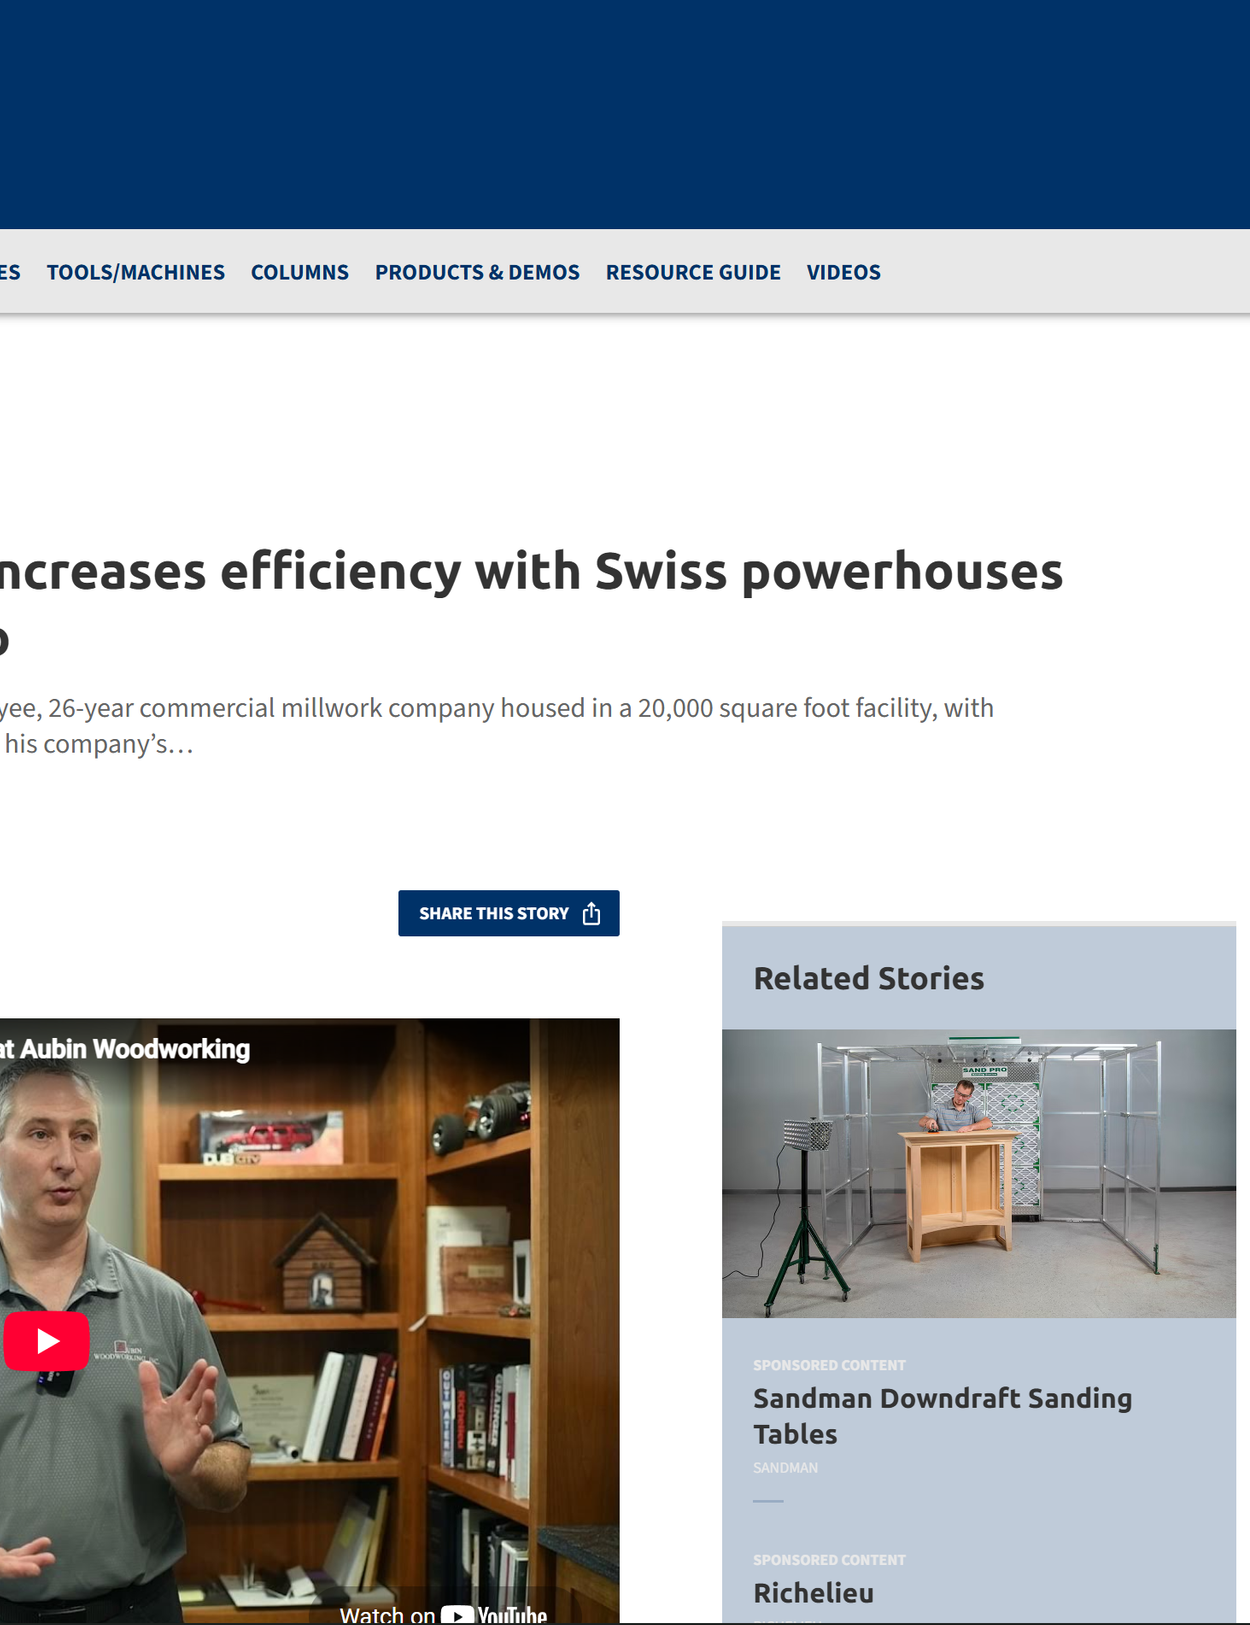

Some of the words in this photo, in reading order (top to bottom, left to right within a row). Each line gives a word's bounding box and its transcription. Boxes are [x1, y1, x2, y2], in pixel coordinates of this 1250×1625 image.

[46, 262, 226, 284] TOOLS/MACHINES
[250, 263, 350, 281] COLUMNS
[375, 263, 485, 281] PRODUCTS
[488, 263, 505, 281] &
[508, 263, 581, 281] DEMOS
[606, 263, 714, 281] RESOURCE
[718, 263, 782, 281] GUIDE
[806, 263, 882, 281] VIDEOS
[221, 548, 462, 599] efficiency
[474, 548, 580, 591] with
[595, 548, 727, 591] Swiss
[743, 548, 1063, 599] powerhouses
[48, 698, 135, 724] 26-year
[139, 696, 276, 718] commercial
[282, 696, 383, 718] millwork
[388, 702, 496, 724] company
[501, 696, 585, 718] housed
[592, 697, 613, 718] in
[619, 702, 632, 718] a
[638, 698, 714, 722] 20,000
[719, 702, 798, 724] square
[803, 696, 851, 718] foot
[855, 696, 938, 724] facility,
[943, 696, 994, 718] with
[5, 732, 38, 754] his
[419, 906, 473, 921] SHARE
[475, 906, 514, 921] THIS
[516, 906, 570, 921] STORY
[755, 964, 870, 991] Related
[878, 964, 985, 991] Stories
[19, 1037, 87, 1059] Aubin
[92, 1037, 250, 1064] Woodworking
[203, 1153, 234, 1166] DUB
[753, 1359, 839, 1372] SPONSORED
[841, 1359, 907, 1372] CONTENT
[442, 1369, 452, 1450] OUTWATER
[491, 1373, 504, 1448] GRAINGER
[753, 1386, 872, 1409] Sandman
[881, 1385, 1021, 1409] Downdraft
[1028, 1385, 1132, 1414] Sanding
[753, 1421, 838, 1445] Tables
[752, 1461, 818, 1474] SANDMAN
[753, 1554, 839, 1566] SPONSORED
[841, 1554, 907, 1566] CONTENT
[754, 1580, 874, 1604] Richelieu
[340, 1606, 404, 1623] Watch
[410, 1610, 436, 1623] on
[477, 1606, 548, 1623] YouTube
